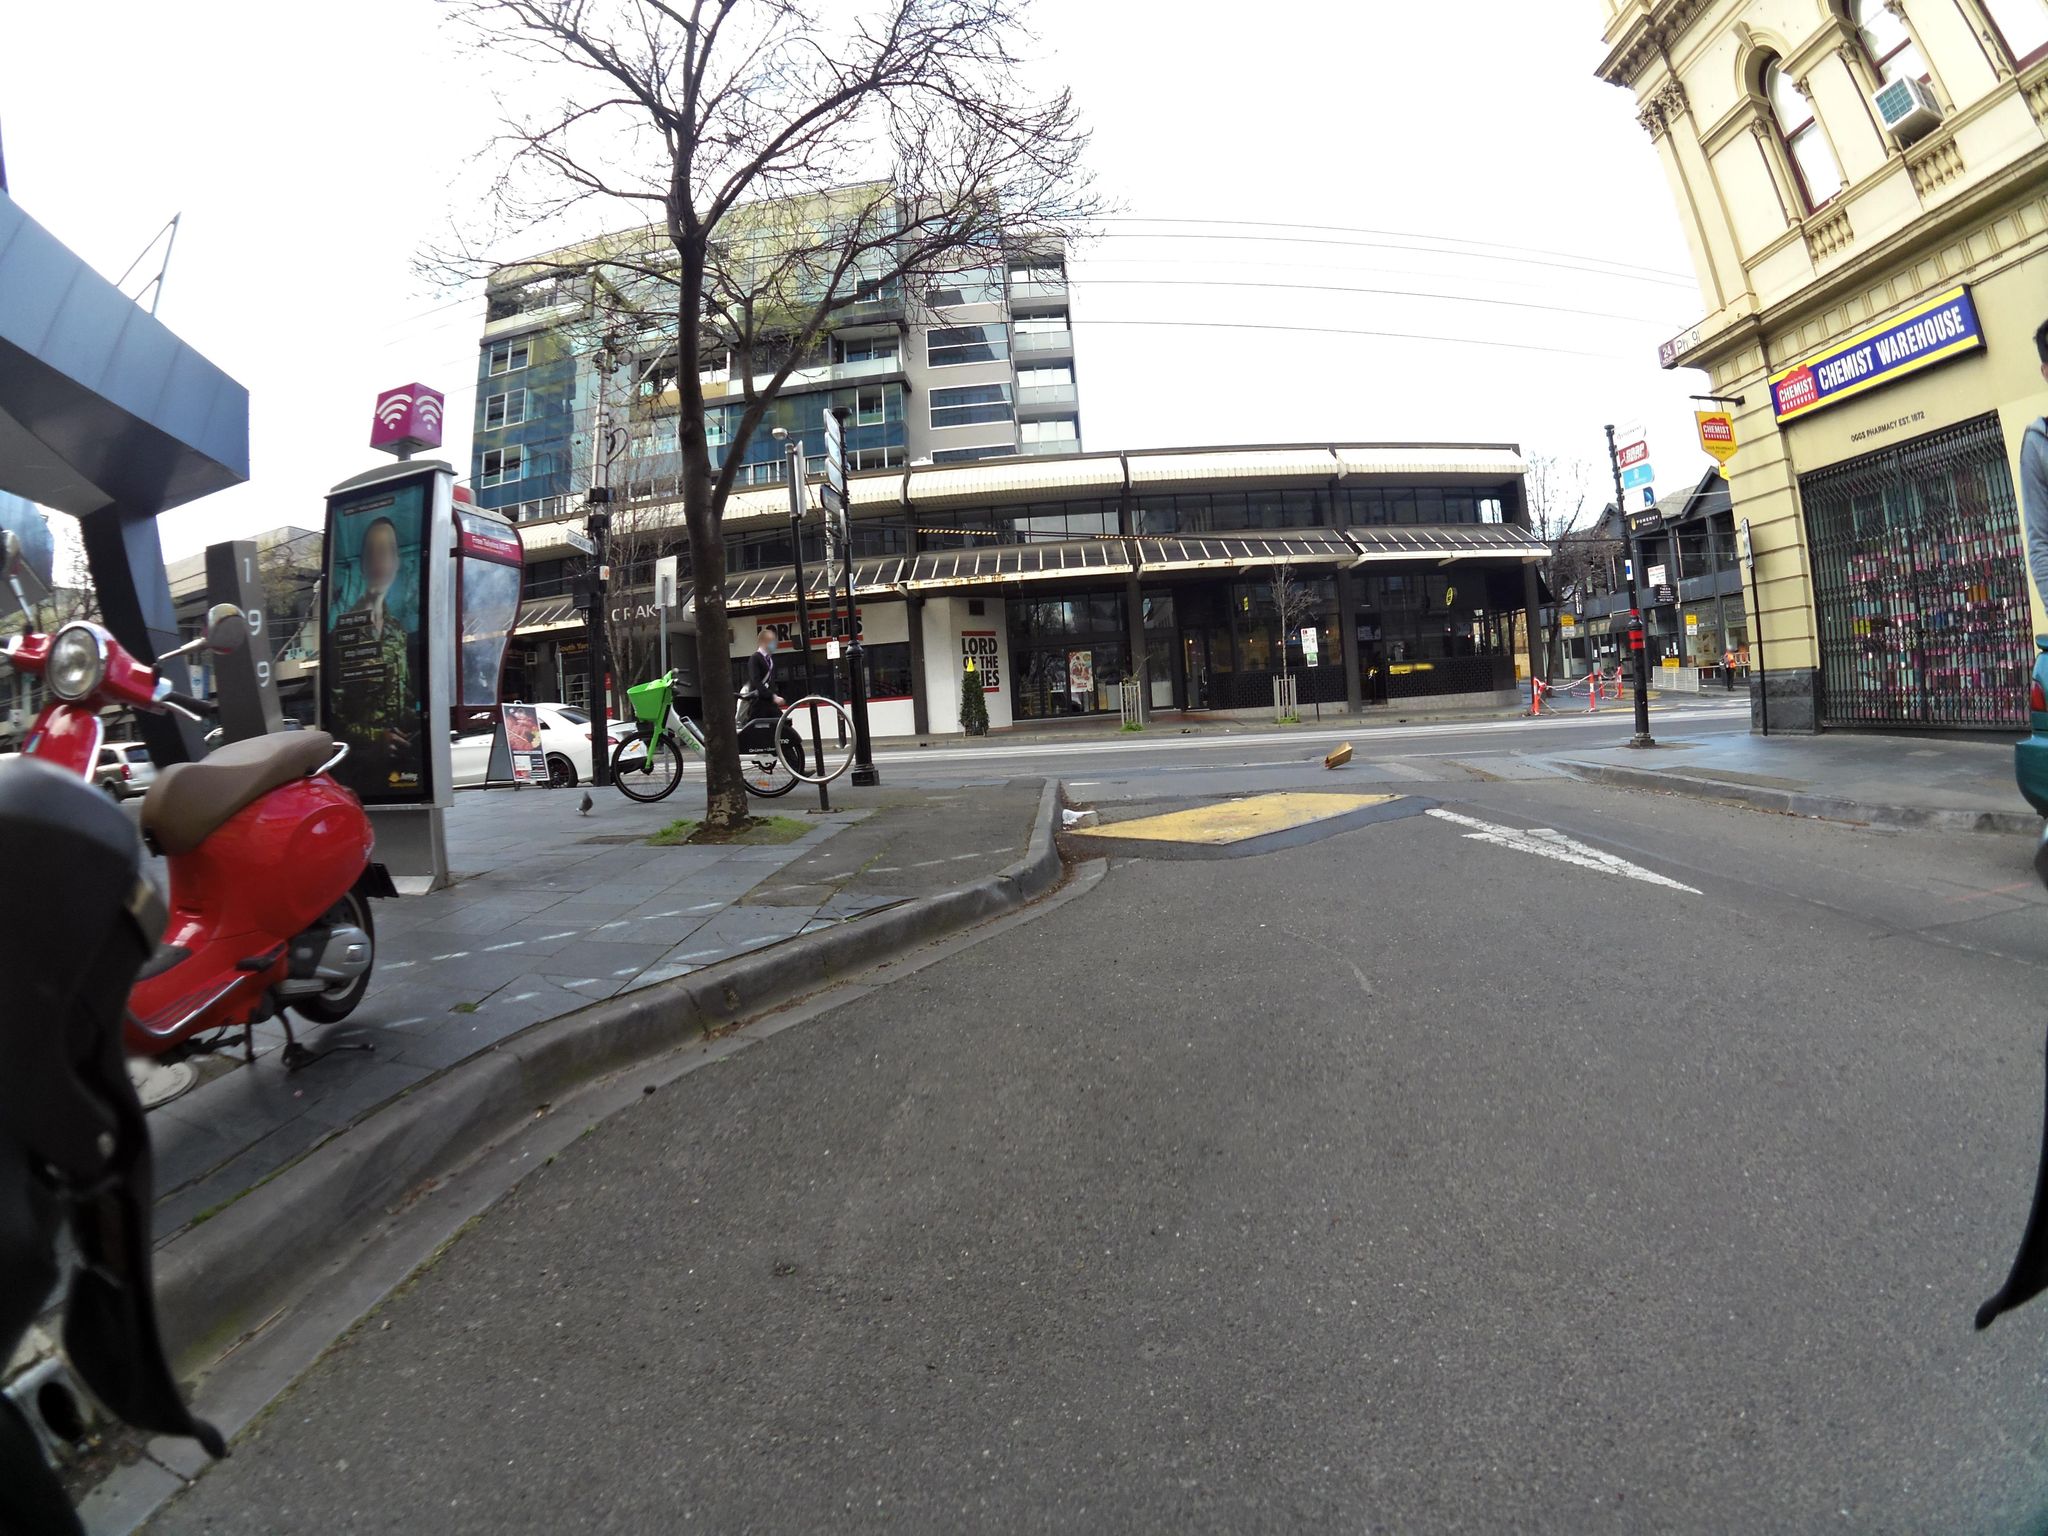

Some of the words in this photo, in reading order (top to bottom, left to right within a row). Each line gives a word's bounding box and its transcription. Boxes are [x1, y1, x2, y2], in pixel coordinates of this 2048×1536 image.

[1818, 346, 1874, 390] CHEMIST
[1876, 306, 1964, 365] WAREHOUSE
[1779, 377, 1814, 402] CHEMIST
[1781, 392, 1815, 411] WAREHOUSE
[1703, 424, 1729, 434] CHEMIST
[1851, 430, 1866, 442] OGGS
[1866, 420, 1898, 438] PHARMACY
[1898, 416, 1911, 428] EST.
[1911, 411, 1925, 424] 1872
[961, 637, 998, 655] LORD
[979, 656, 998, 669] THE
[981, 670, 1000, 686] IES
